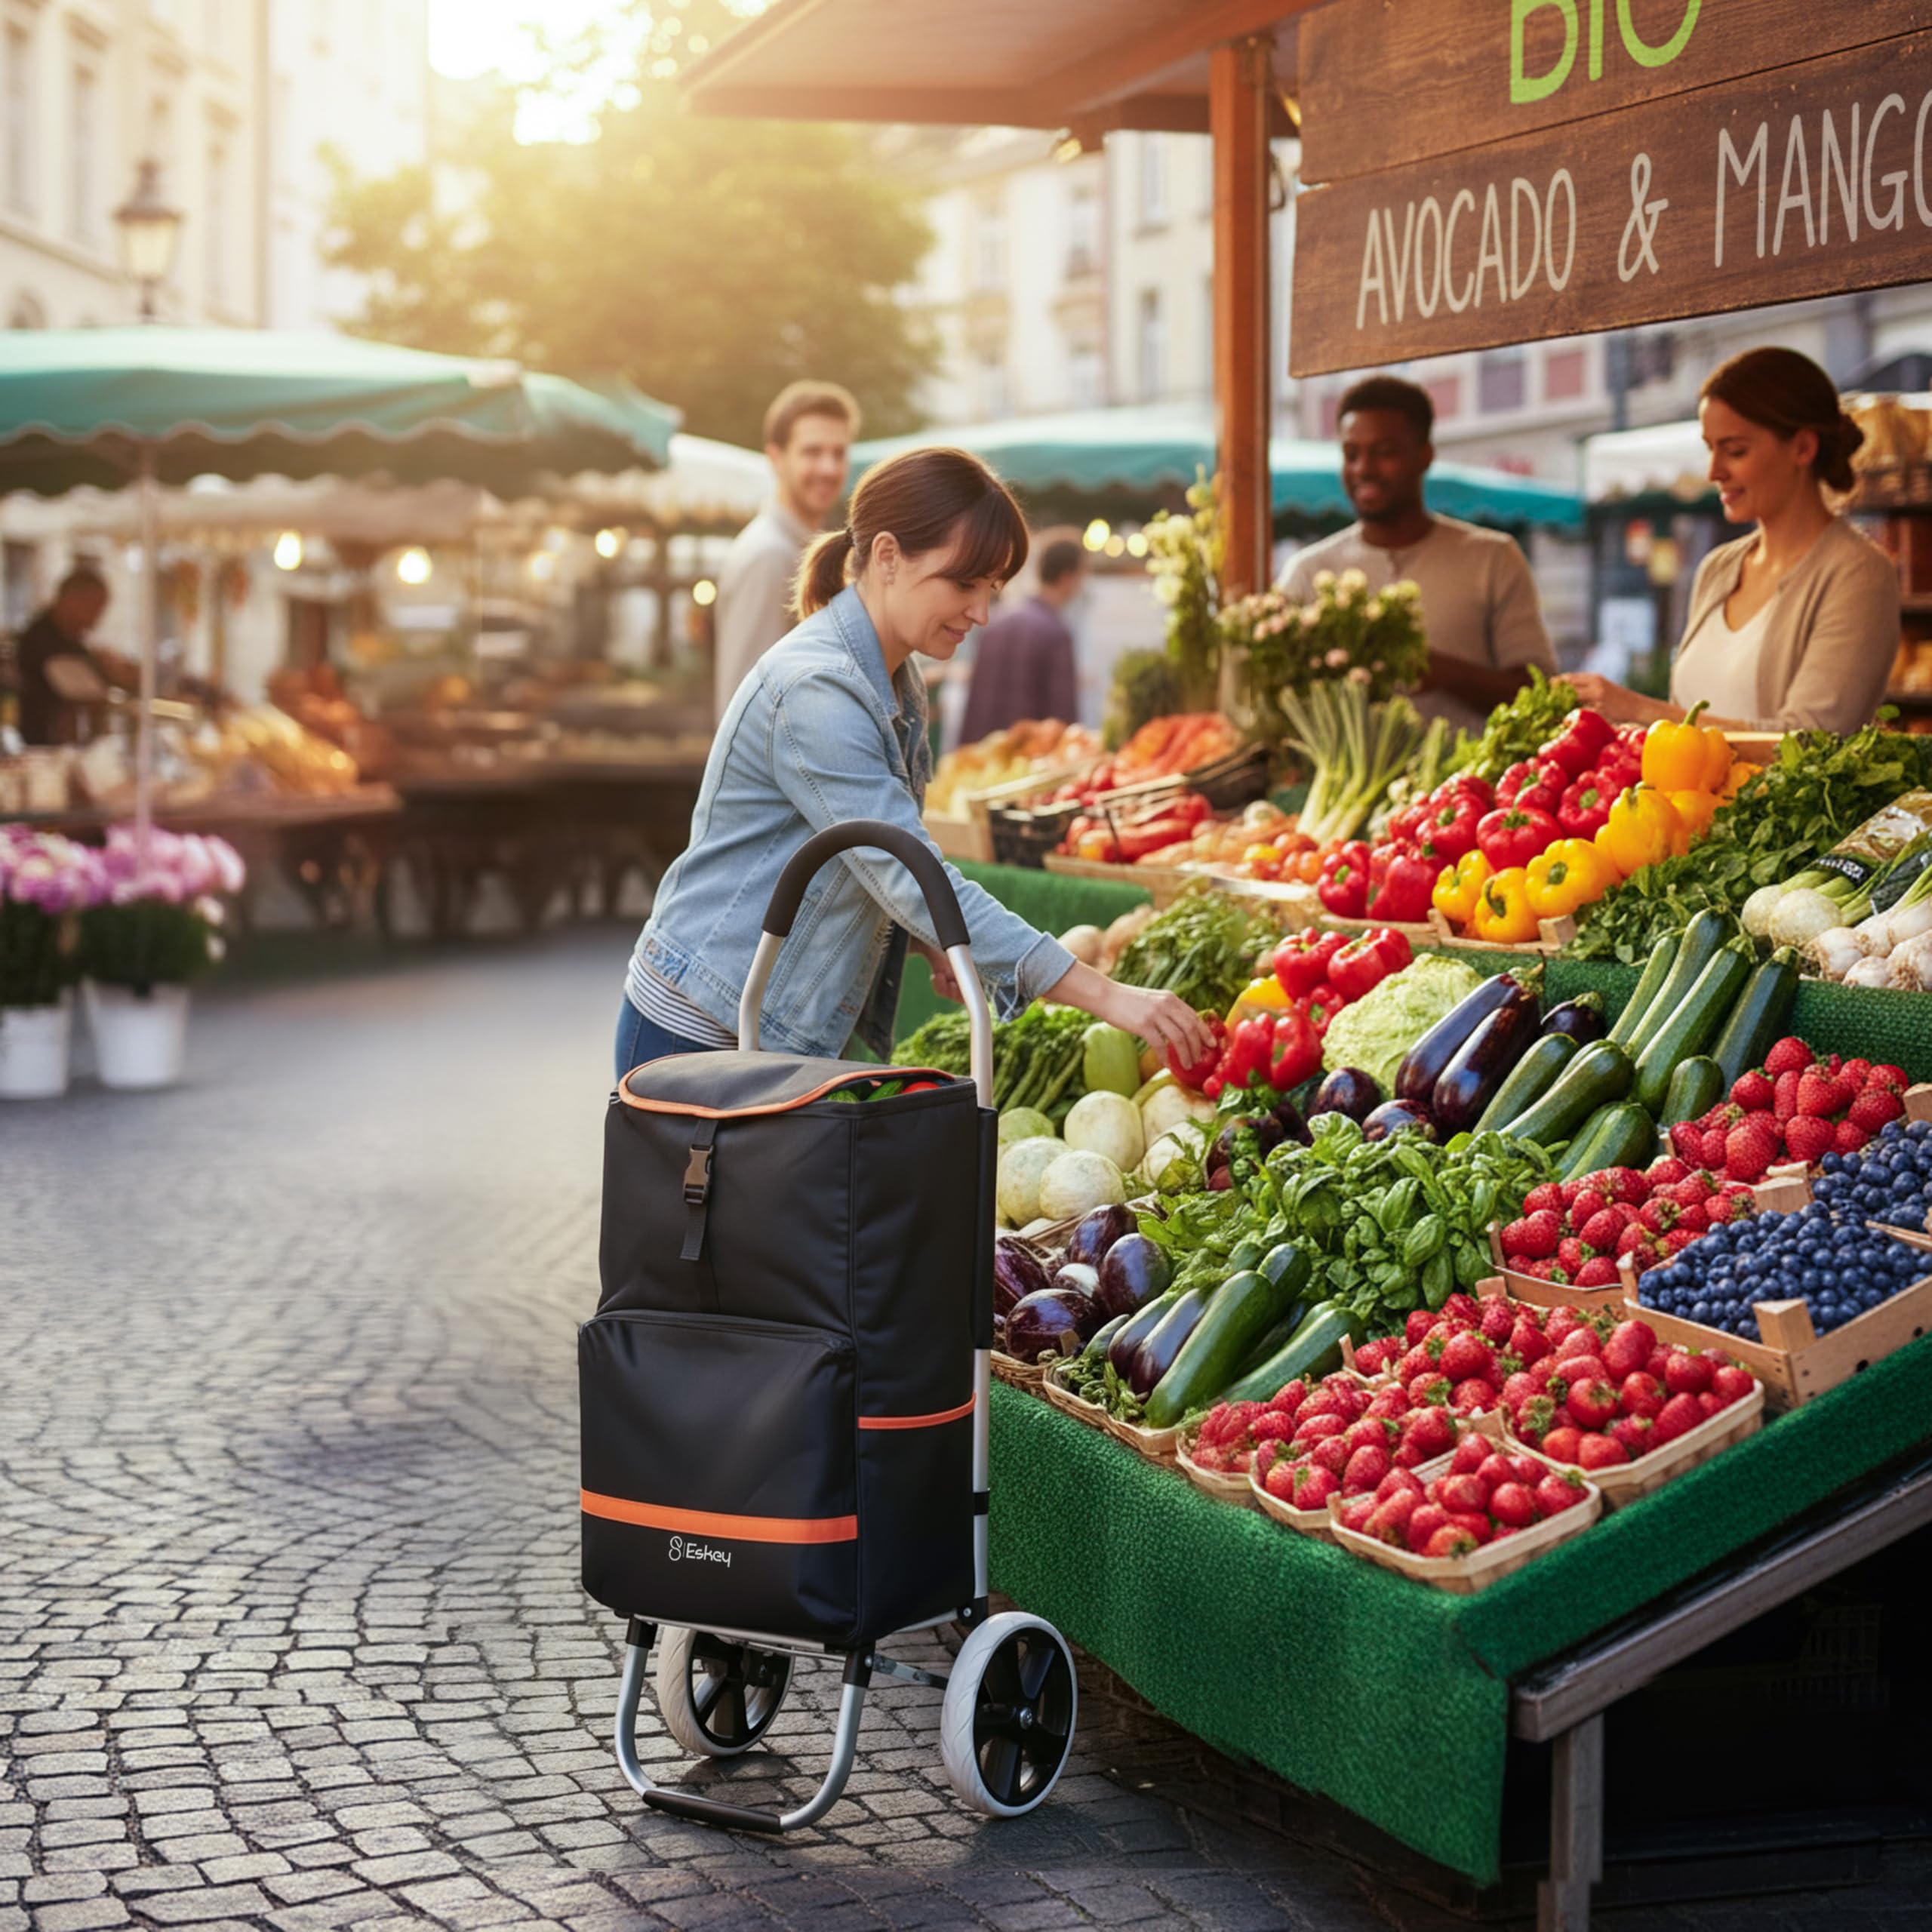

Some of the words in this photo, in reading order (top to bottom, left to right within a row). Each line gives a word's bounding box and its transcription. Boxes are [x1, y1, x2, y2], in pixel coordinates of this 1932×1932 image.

[1355, 168, 1577, 331] AVOCADO
[1617, 152, 1669, 282] &
[685, 1543, 731, 1568] Eskey
